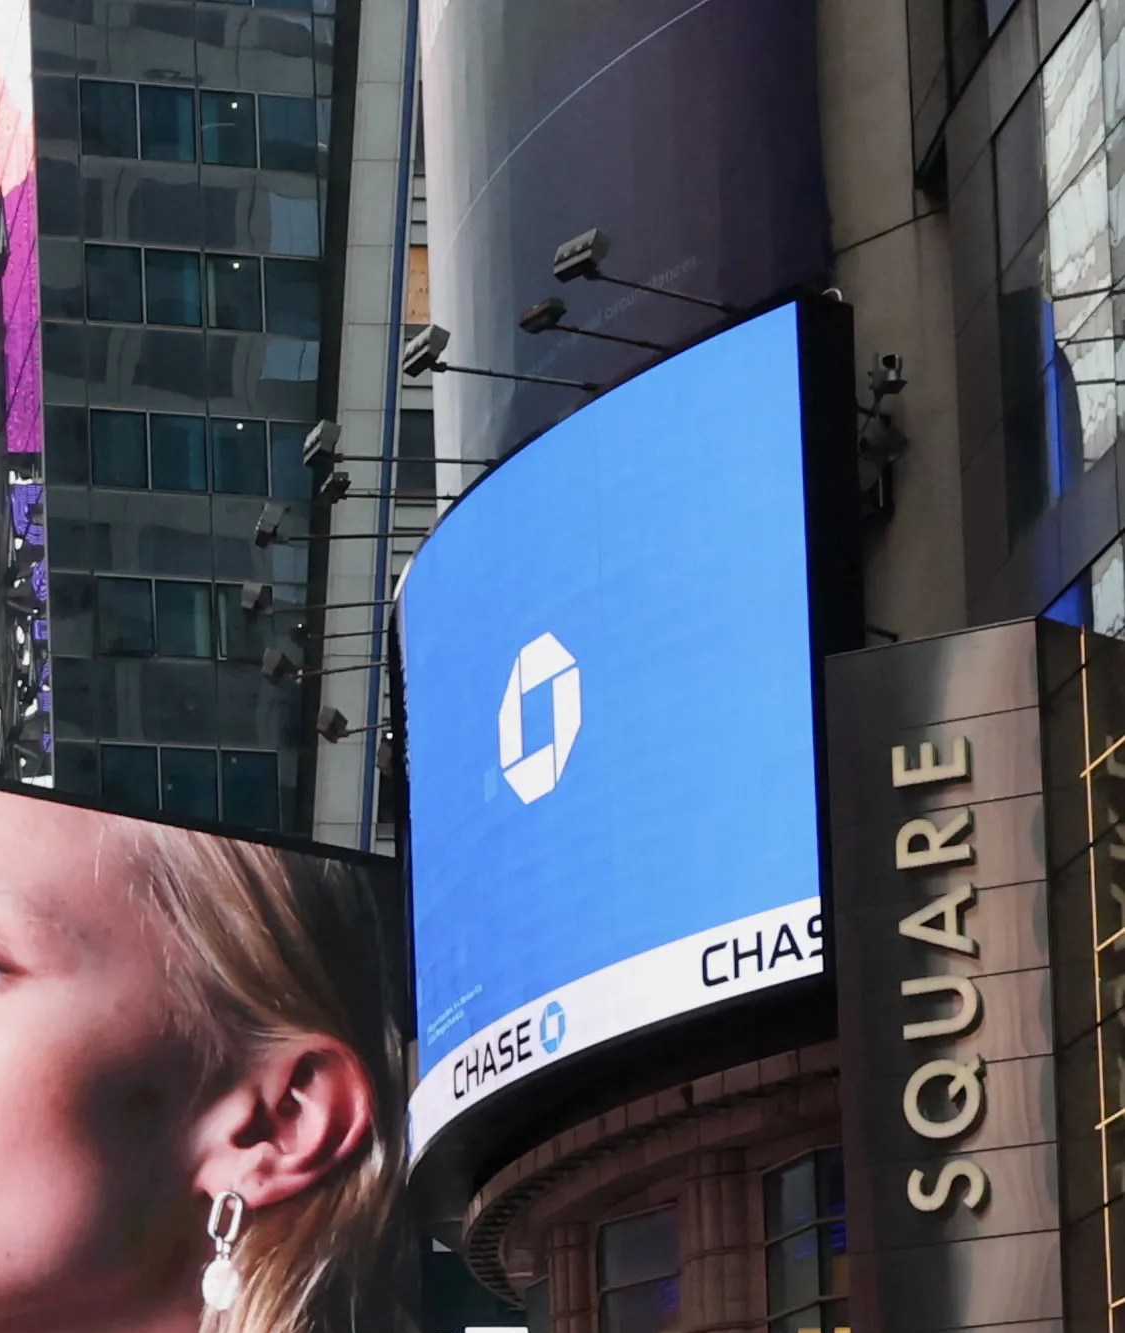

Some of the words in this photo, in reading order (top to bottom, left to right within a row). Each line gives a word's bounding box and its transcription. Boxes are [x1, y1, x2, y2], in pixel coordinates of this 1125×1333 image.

[701, 912, 824, 988] CHAS
[892, 736, 988, 1213] SQUARE
[453, 1018, 533, 1100] CHASE
